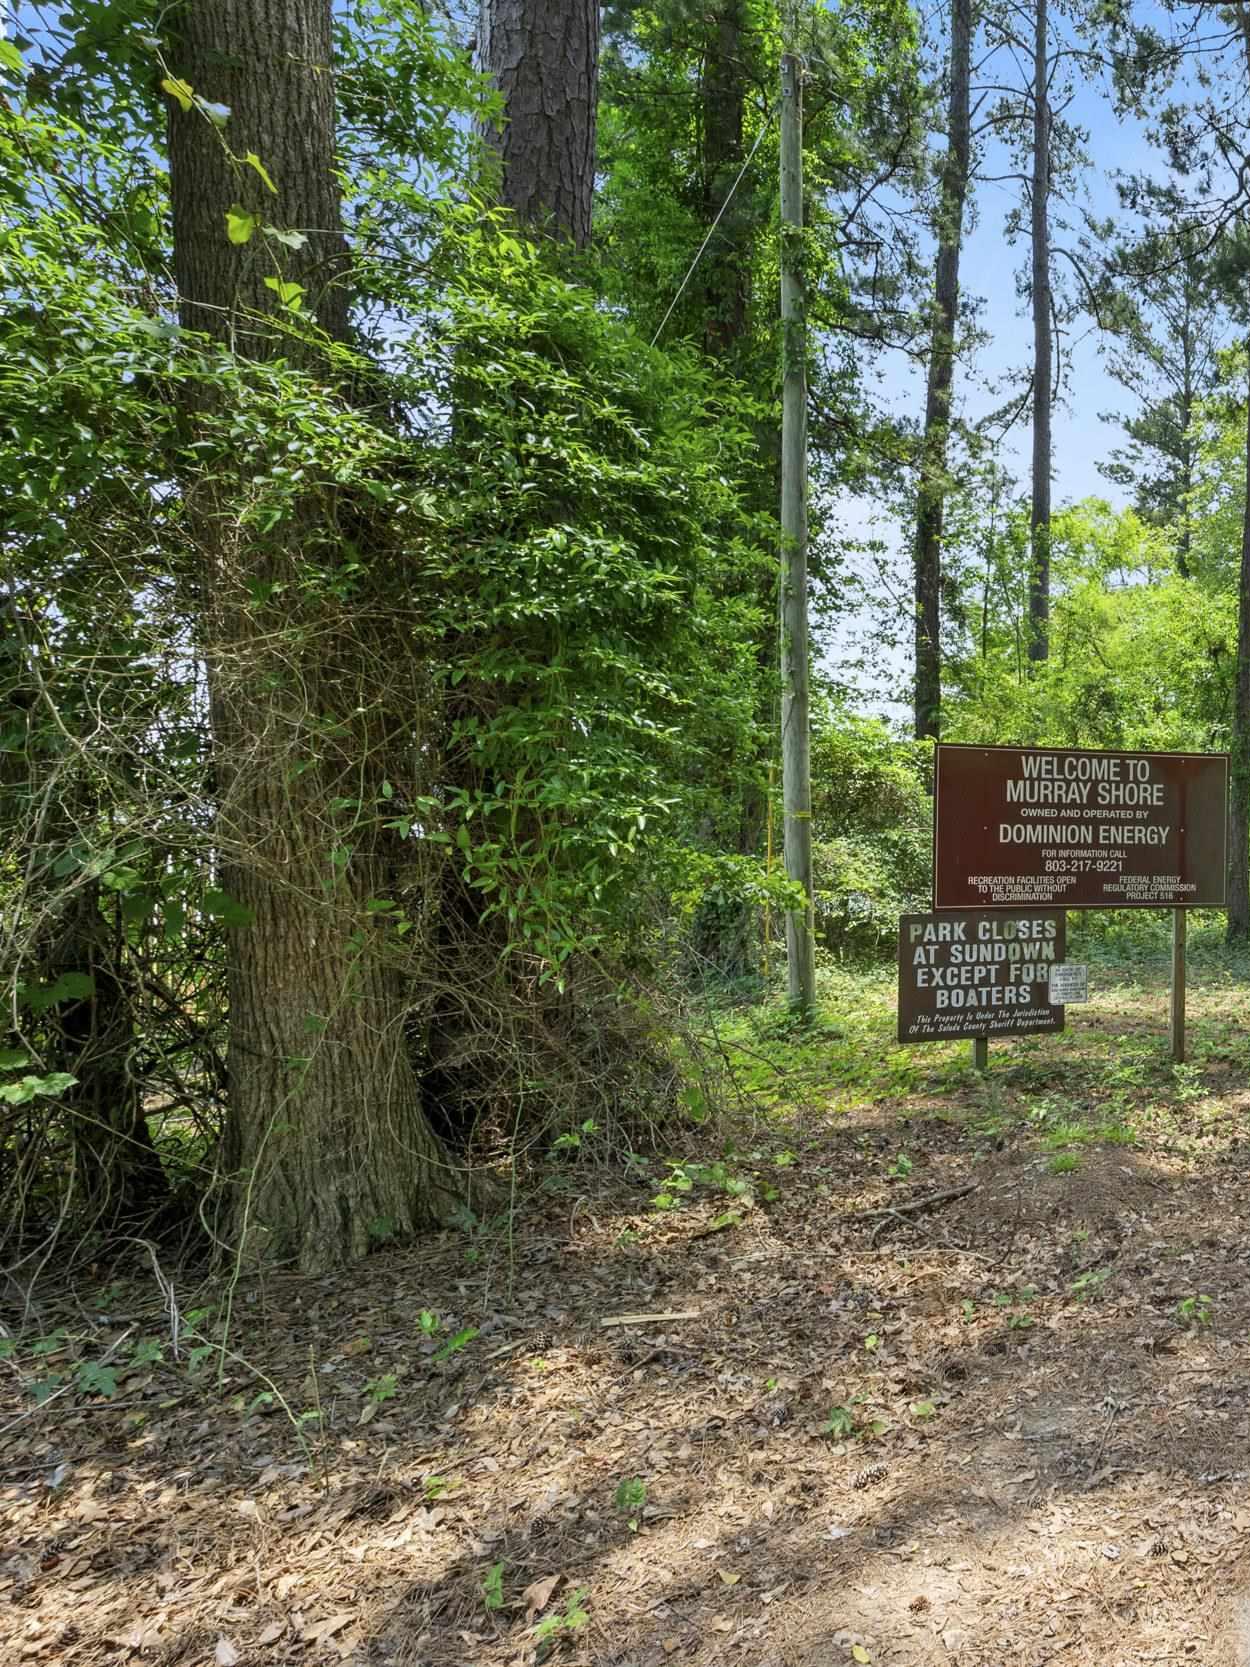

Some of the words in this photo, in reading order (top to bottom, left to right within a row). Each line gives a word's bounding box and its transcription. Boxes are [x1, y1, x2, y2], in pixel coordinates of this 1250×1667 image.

[1021, 756, 1120, 780] WELCOME
[1126, 760, 1150, 782] TO
[1006, 780, 1092, 804] MURRAY
[1097, 784, 1164, 806] SHORE
[1020, 808, 1058, 818] OWNED
[1060, 809, 1080, 818] AND
[1083, 810, 1134, 818] OPERATED
[1136, 810, 1148, 819] BY
[999, 824, 1092, 844] DOMINION
[1099, 826, 1170, 845] ENERGY
[1042, 850, 1056, 858] FOR
[1058, 850, 1108, 858] INFORMATION
[1110, 850, 1127, 858] CALL
[1045, 860, 1122, 872] 803-217-9221
[968, 876, 1015, 885] RECREATION
[1016, 876, 1054, 884] FACILITIES
[1056, 876, 1076, 884] OPEN
[1120, 876, 1150, 884] FEDERAL
[1152, 876, 1181, 884] ENERGY
[978, 885, 988, 893] TO
[990, 885, 1004, 893] THE
[1034, 884, 1066, 892] WITHOUT
[1104, 884, 1148, 892] REGULATORY
[1150, 884, 1196, 892] COMMISSION
[992, 893, 1052, 902] DISCRIMINATION
[1126, 892, 1158, 900] PROJECT
[909, 922, 967, 943] PARK
[978, 920, 1057, 940] CLOSES
[913, 945, 938, 965] AT
[950, 942, 1056, 963] SUNDOWN
[917, 965, 1000, 987] EXCEPT
[1010, 965, 1049, 983] FOR
[936, 986, 1031, 1008] BOATERS
[916, 1016, 931, 1024] This
[934, 1013, 964, 1023] Property
[998, 1010, 1011, 1018] The
[922, 1025, 934, 1033] The
